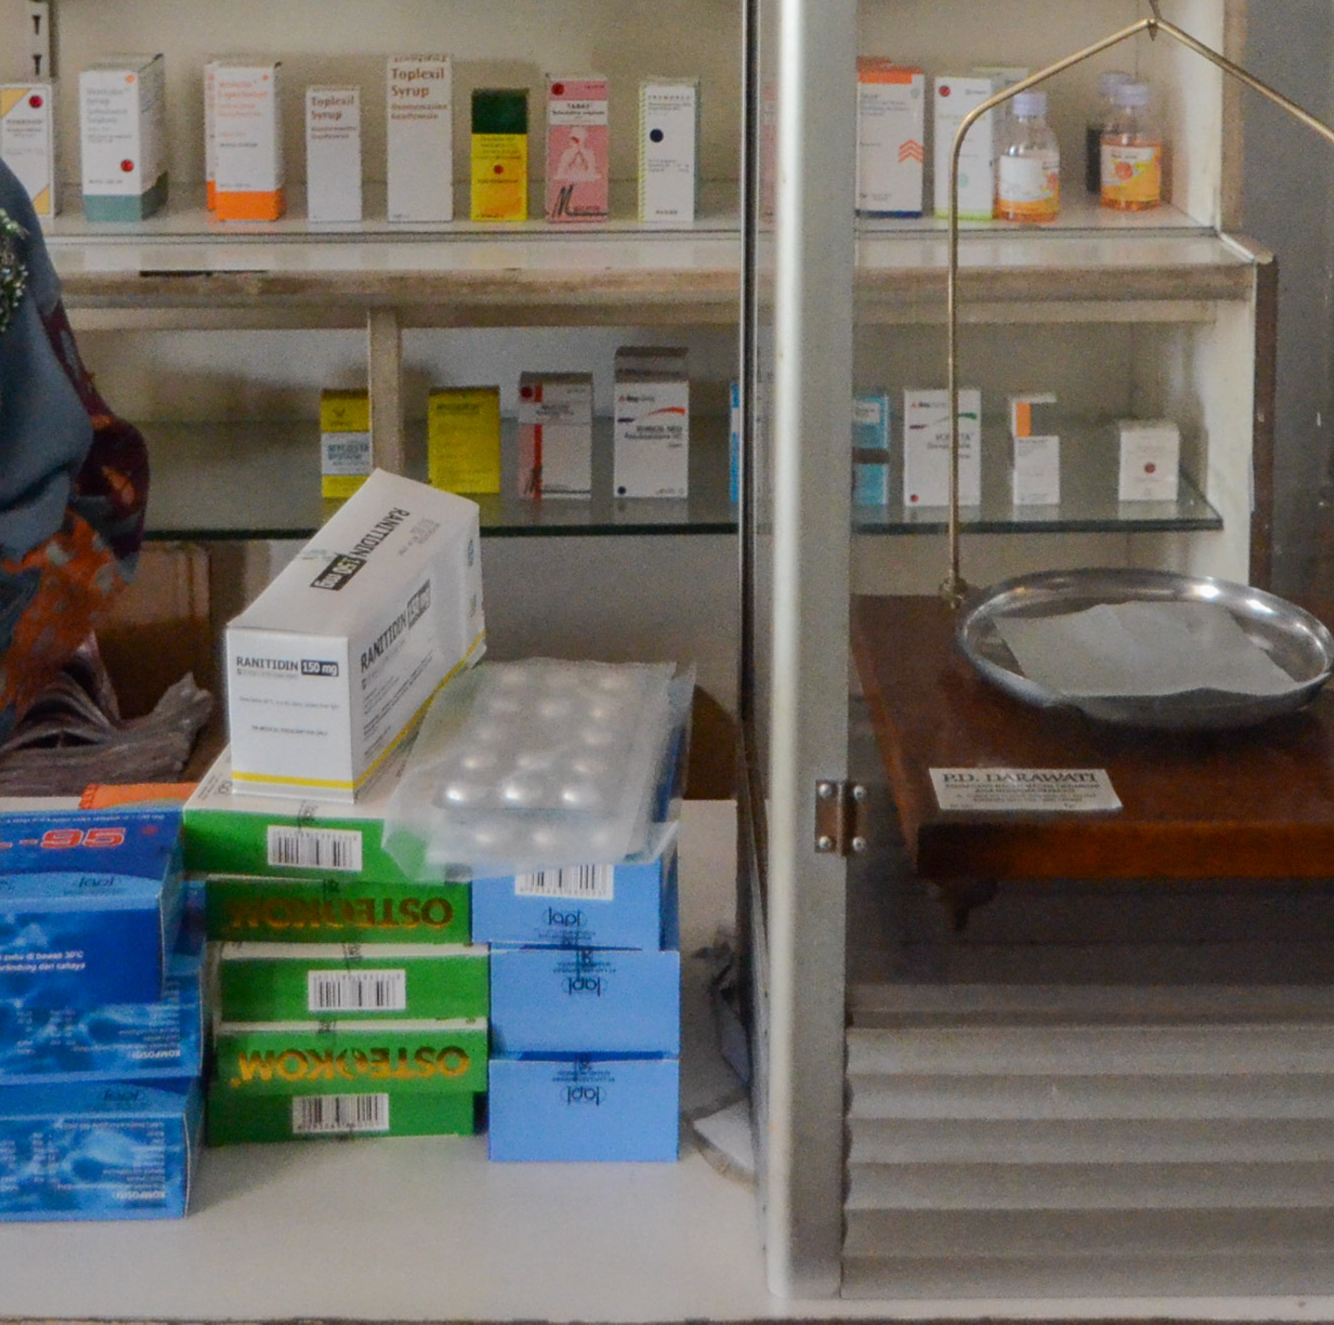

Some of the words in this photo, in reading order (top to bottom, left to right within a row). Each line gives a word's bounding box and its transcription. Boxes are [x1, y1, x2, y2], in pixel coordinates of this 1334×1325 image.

[391, 68, 446, 82] Toplexil
[391, 85, 430, 99] Syrup
[349, 507, 411, 558] RANITIDIN
[360, 609, 408, 674] RANITIDIN
[235, 656, 299, 671] RANITIDIN
[301, 661, 320, 674] 150
[321, 663, 337, 676] mg
[236, 1044, 471, 1083] OSTEOKOM
